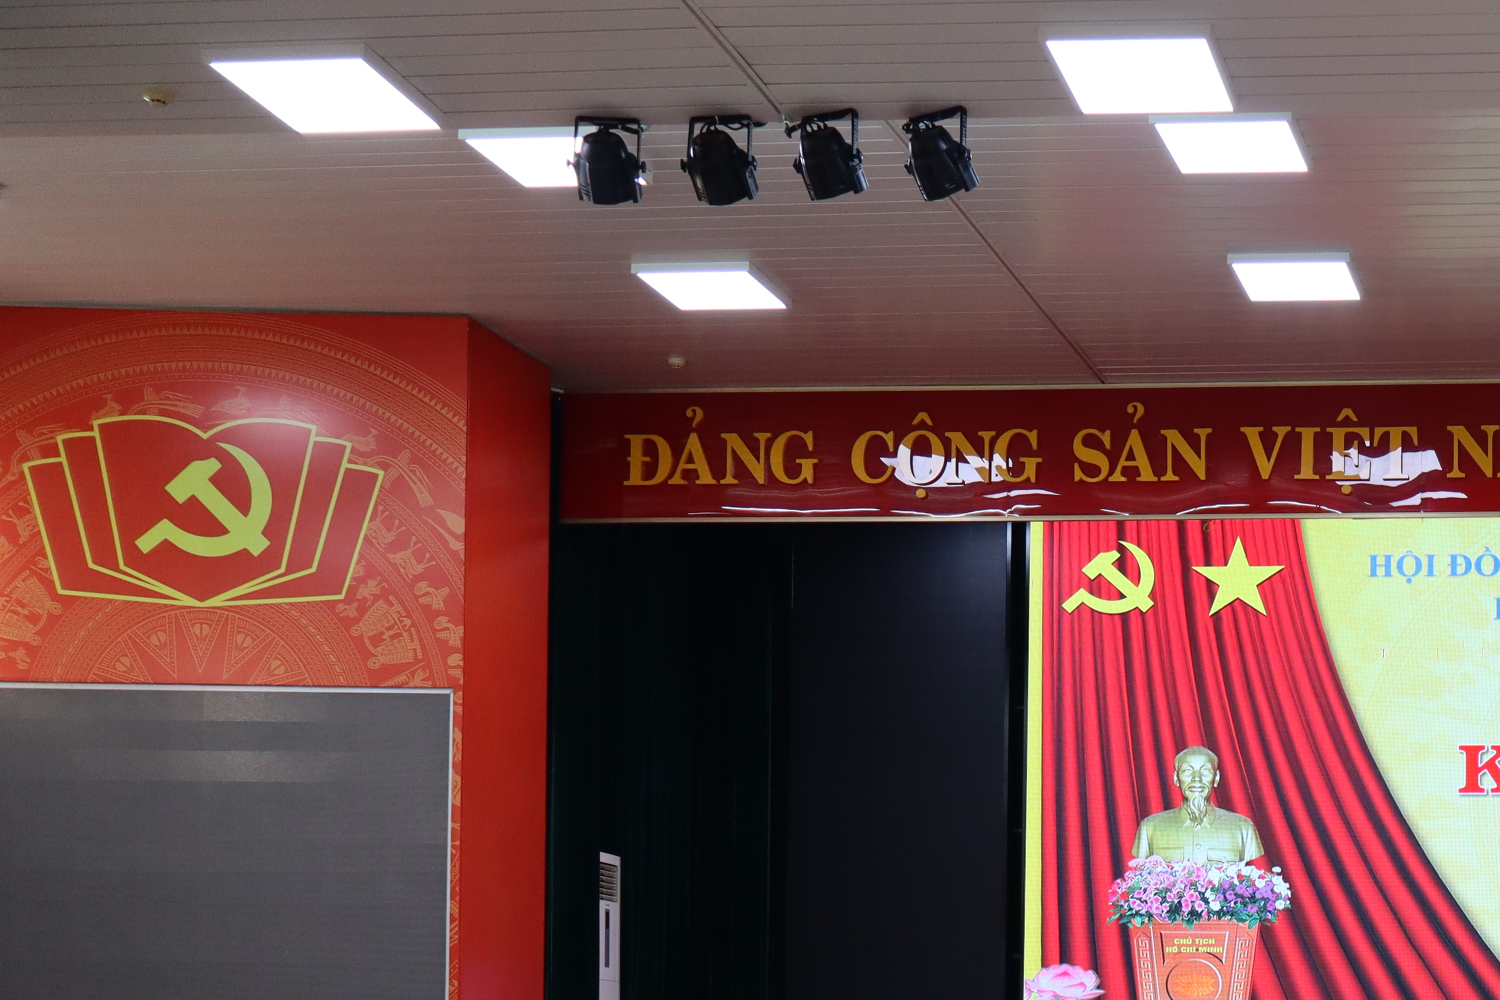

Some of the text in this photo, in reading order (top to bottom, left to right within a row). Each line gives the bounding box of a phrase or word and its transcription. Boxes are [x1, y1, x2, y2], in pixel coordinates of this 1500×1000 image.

[623, 406, 818, 486] ĐẢNG
[850, 412, 1043, 498] CỘNG
[1072, 402, 1212, 483] SẢN
[1240, 407, 1418, 495] VIỆT
[1368, 550, 1437, 583] HỘI
[1174, 937, 1216, 946] CHỦ TỊCH
